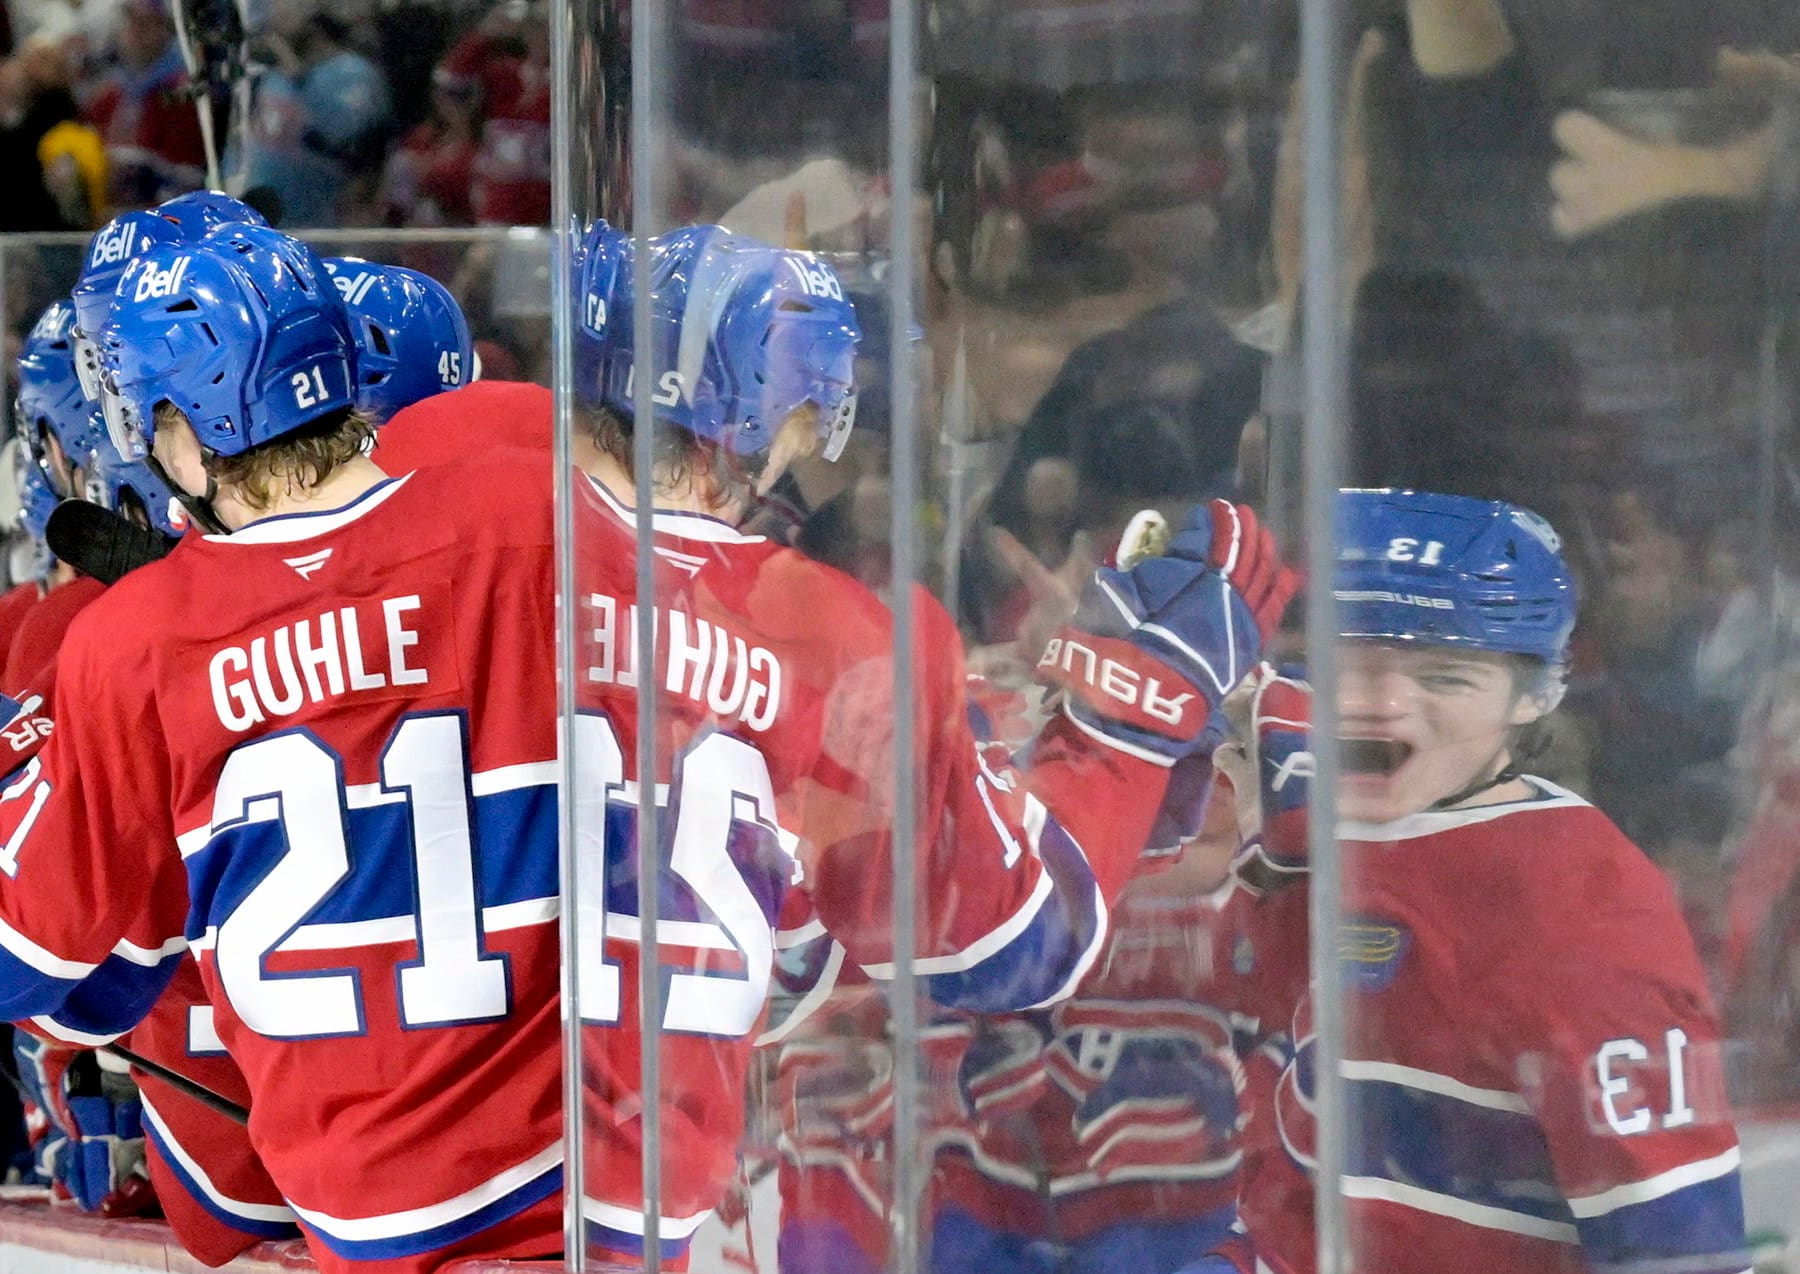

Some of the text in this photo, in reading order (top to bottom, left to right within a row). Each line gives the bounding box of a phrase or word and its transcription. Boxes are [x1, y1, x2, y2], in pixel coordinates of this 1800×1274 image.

[91, 222, 137, 268] Bell
[134, 256, 193, 303] Bell
[325, 262, 378, 306] ell
[291, 365, 330, 409] 21
[437, 351, 460, 385] 45
[208, 594, 429, 732] GUHLE
[209, 708, 513, 1043] 21
